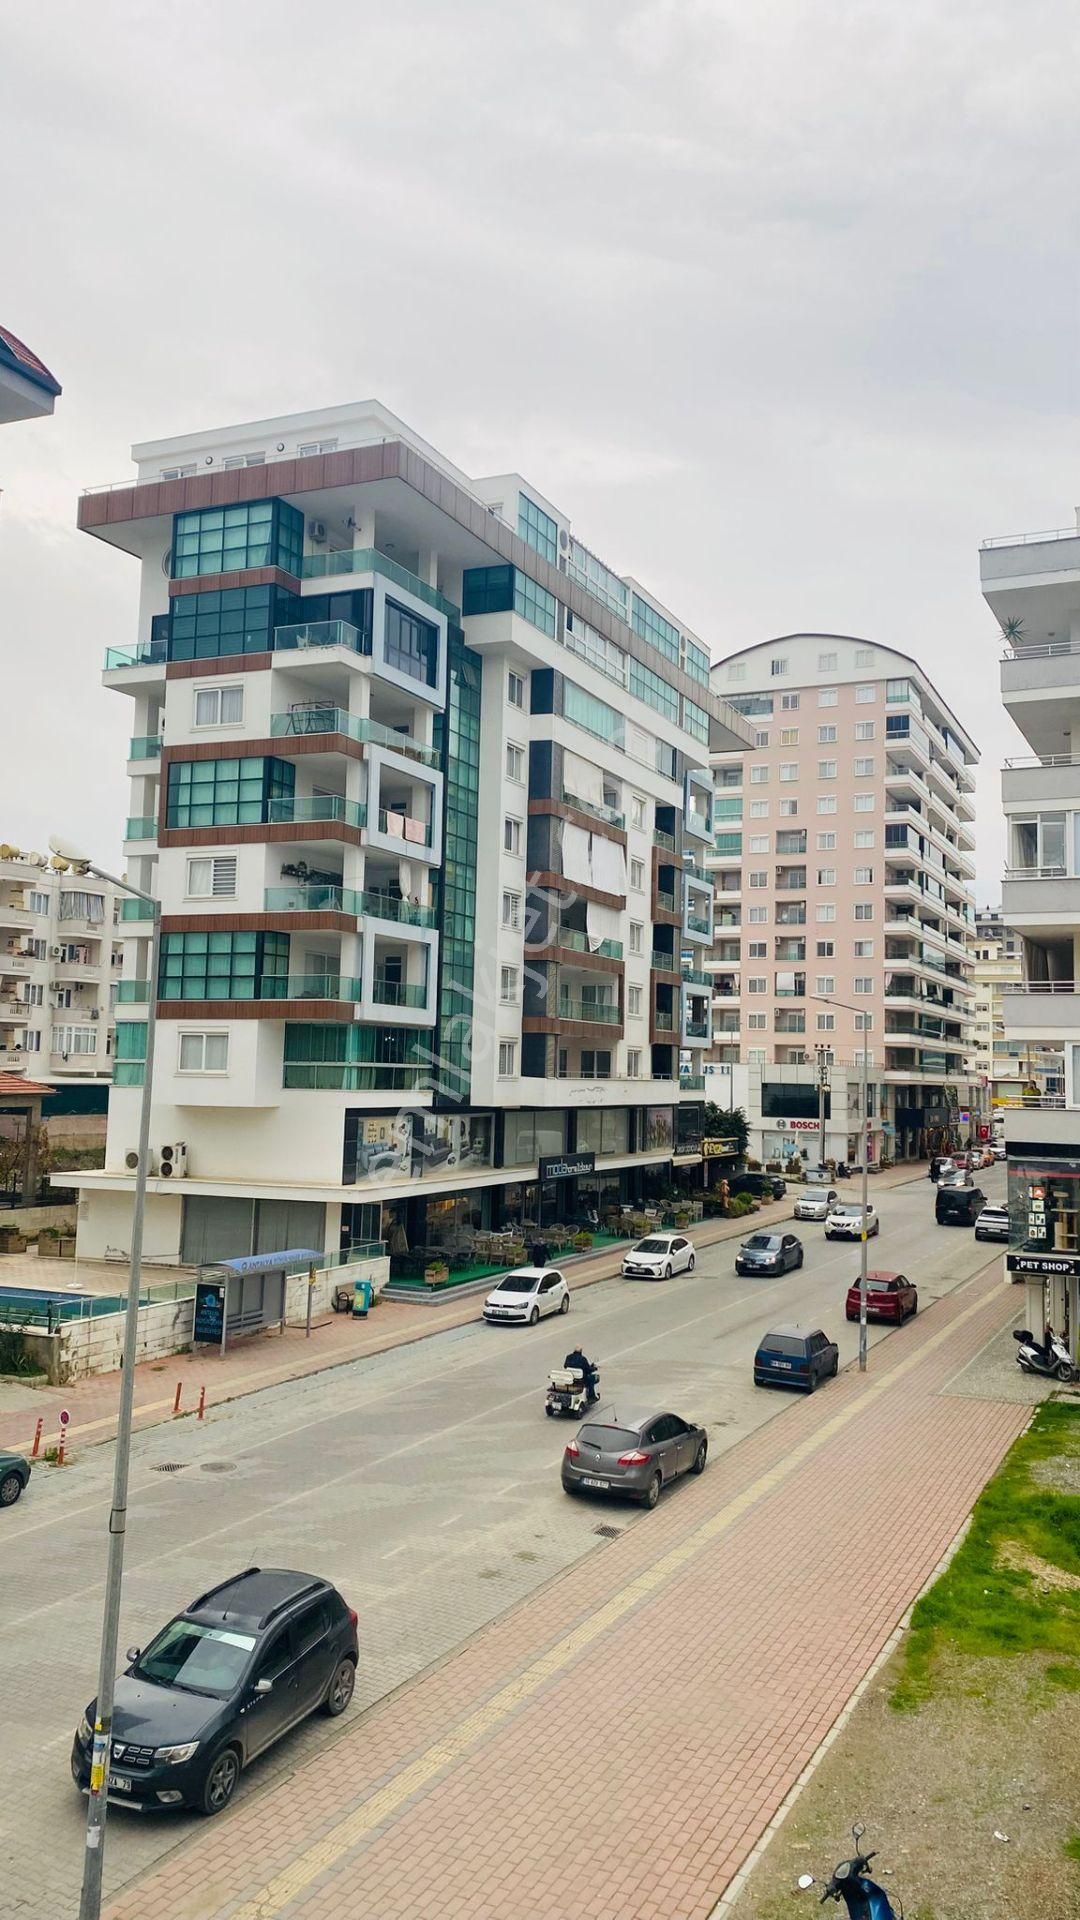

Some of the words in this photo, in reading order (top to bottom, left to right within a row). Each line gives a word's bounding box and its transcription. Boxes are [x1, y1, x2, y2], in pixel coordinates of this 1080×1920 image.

[789, 1121, 820, 1130] BOSCH
[1020, 1260, 1039, 1270] PET
[1041, 1262, 1069, 1272] SHOP
